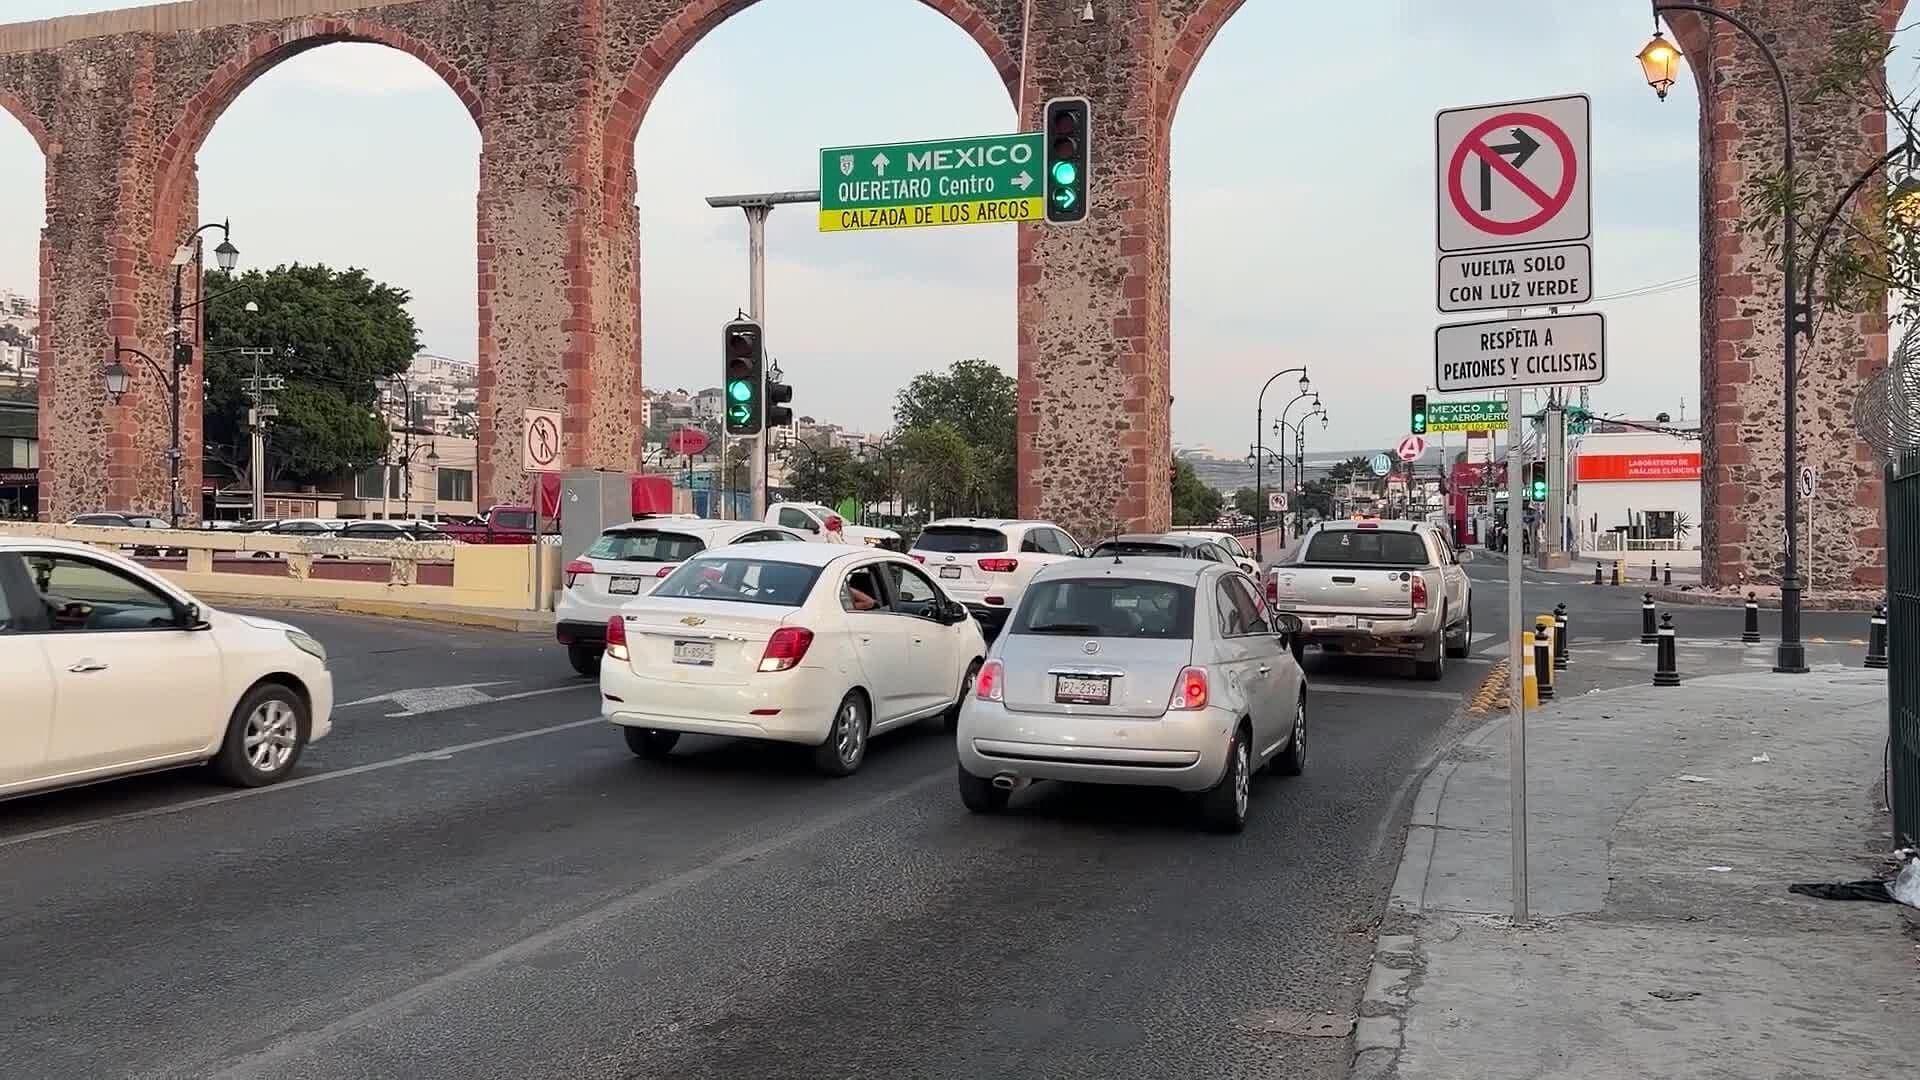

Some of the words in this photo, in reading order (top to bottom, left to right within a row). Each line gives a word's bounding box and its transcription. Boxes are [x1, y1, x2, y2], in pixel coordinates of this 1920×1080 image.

[907, 144, 1032, 172] MEXICO
[839, 179, 930, 202] QUERETARO
[939, 174, 994, 196] Centro
[842, 210, 907, 228] CALZADA
[914, 206, 931, 224] DE
[942, 204, 969, 222] LOS
[978, 200, 1028, 220] ARCOS
[1462, 259, 1514, 278] VUELTA
[1524, 256, 1566, 272] SOLO
[1450, 287, 1482, 302] CON
[1491, 284, 1520, 300] LUZ
[1528, 278, 1578, 296] VERDE
[1480, 330, 1538, 350] RESPETA
[1545, 328, 1552, 346] A
[1444, 359, 1504, 380] PEATONES
[1511, 358, 1518, 374] Y
[1528, 352, 1596, 374] CICLISTAS
[1432, 404, 1480, 413] MEXICO
